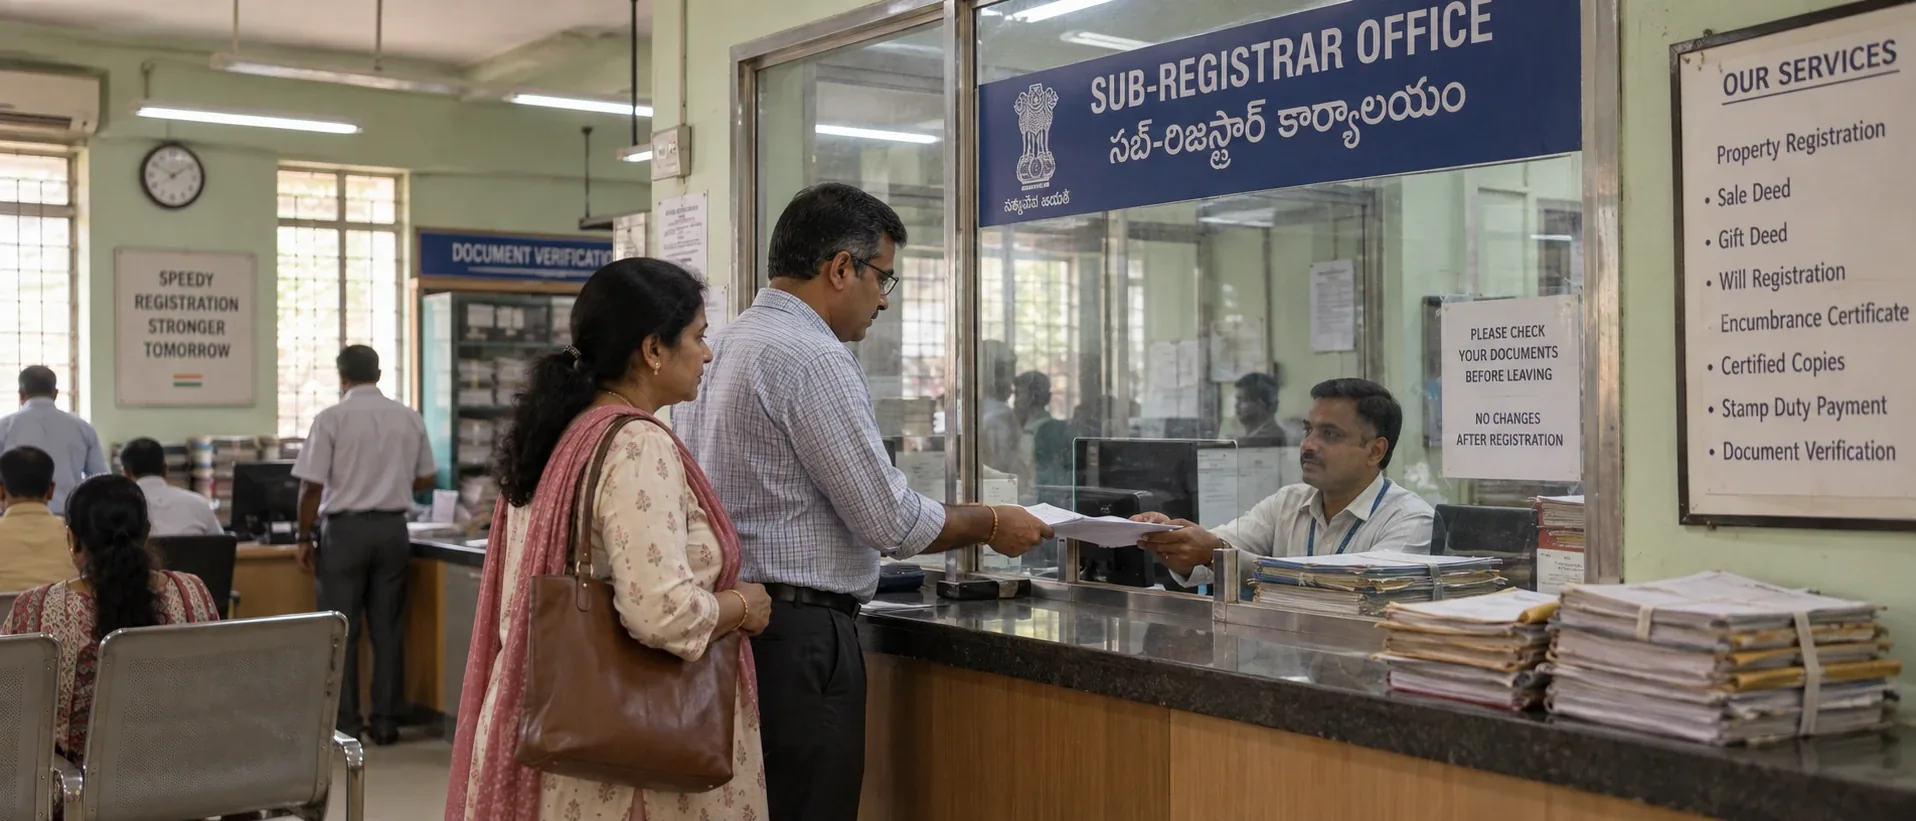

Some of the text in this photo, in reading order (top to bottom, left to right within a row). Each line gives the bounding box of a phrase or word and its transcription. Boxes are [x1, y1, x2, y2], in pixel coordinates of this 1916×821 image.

[1090, 0, 1493, 115] SUB-REGISTRAR OFFICE
[1723, 39, 1898, 96] OUR SERVICES
[1277, 75, 1467, 149] కార్యాలయం
[1717, 119, 1886, 165] Property Registration
[1717, 177, 1791, 207] Sale Deed
[1718, 222, 1788, 249] Gift Deed
[452, 242, 532, 266] DOCUMENT
[534, 246, 613, 268] VERIFICATIO
[159, 270, 214, 288] SPEEDY
[1719, 261, 1846, 292] Will Registration
[134, 293, 239, 312] REGISTRATION
[148, 317, 225, 335] STRONGER
[1720, 302, 1910, 333] Encumbrance Certificate
[1470, 324, 1546, 341] PLEASE CHECK
[143, 341, 231, 359] TOMORROW
[1458, 345, 1559, 362] YOUR DOCUMENTS
[1465, 367, 1553, 383] BEFORE LEAVING
[1721, 351, 1846, 377] Certified Copies
[1475, 412, 1541, 425] NO CHANGES
[1722, 395, 1888, 422] Stamp Duty Payment
[1456, 433, 1564, 447] AFTER REGISTRATION
[1723, 438, 1896, 462] Document Verification
